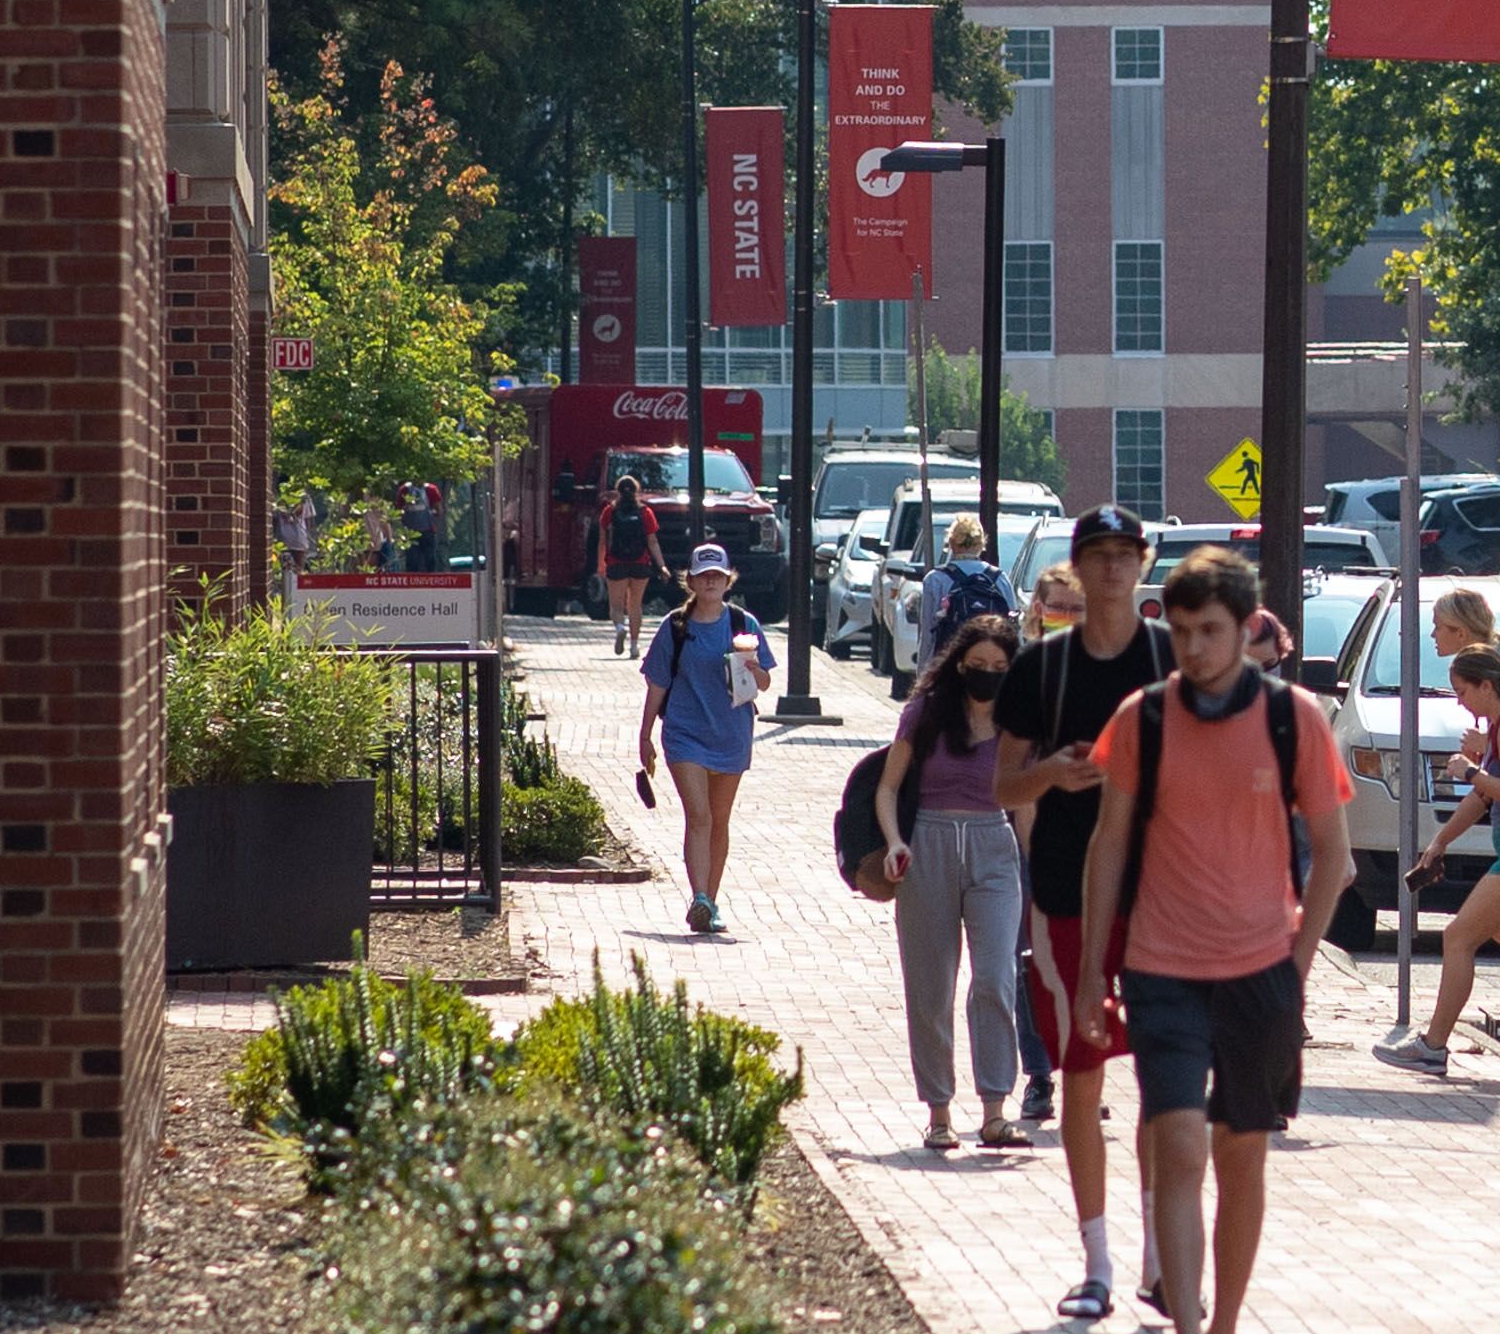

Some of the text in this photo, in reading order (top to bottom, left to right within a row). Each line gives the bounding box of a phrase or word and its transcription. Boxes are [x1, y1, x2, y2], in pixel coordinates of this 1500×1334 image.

[861, 68, 900, 79] THINK
[855, 85, 906, 96] AND DO
[870, 100, 891, 110] THE
[834, 116, 926, 126] EXTRAORDINARY
[732, 153, 760, 279] NC STATE
[275, 341, 310, 366] FDC
[365, 576, 458, 586] NC STATE UNIVERSITY
[352, 602, 426, 617] Residence
[431, 602, 459, 616] Hall
